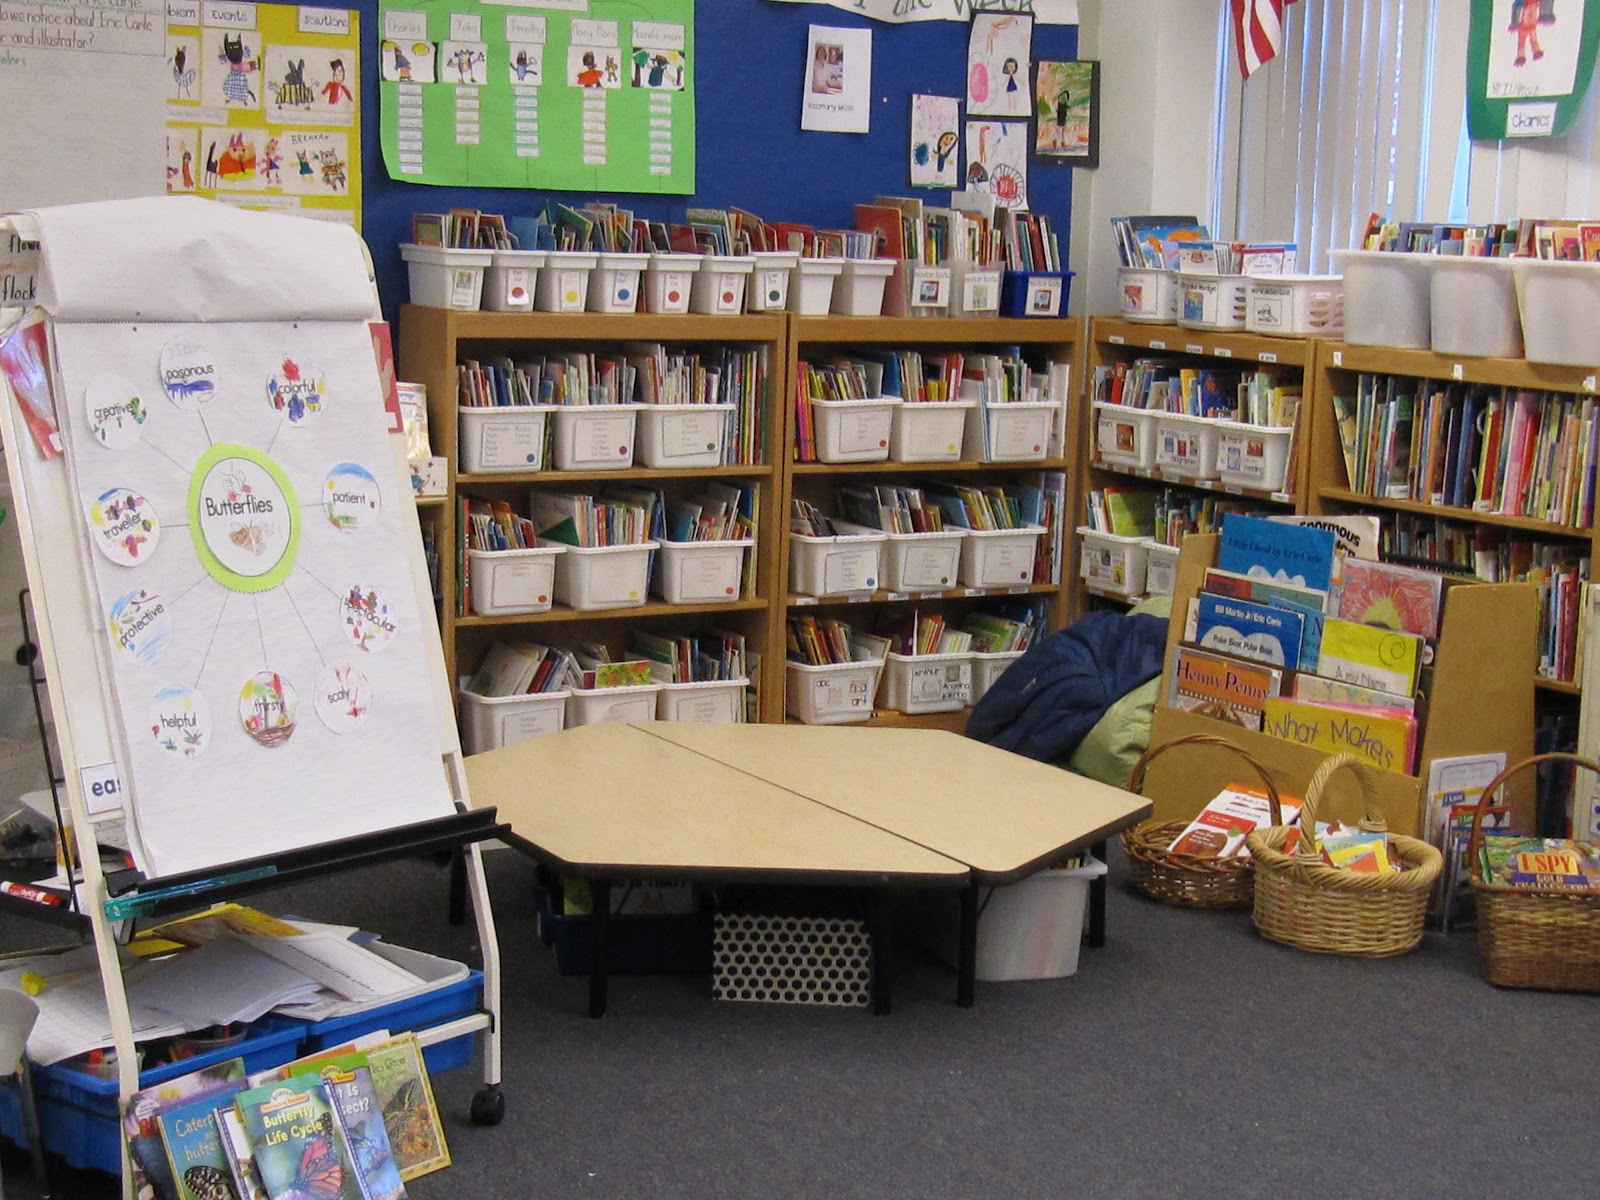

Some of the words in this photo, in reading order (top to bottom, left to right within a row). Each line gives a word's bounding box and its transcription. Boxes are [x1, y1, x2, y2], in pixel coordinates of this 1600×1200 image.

[65, 8, 95, 27] about
[125, 12, 152, 31] Carle
[12, 28, 34, 45] and
[3, 274, 36, 301] flock
[166, 364, 213, 380] poisonous
[278, 379, 315, 395] colorful
[94, 402, 133, 419] creative
[205, 495, 274, 517] Butterflies
[332, 492, 366, 506] patient
[103, 511, 143, 540] traveller
[344, 597, 396, 633] spectacular
[120, 603, 165, 649] protective
[1177, 659, 1221, 688] Henny
[1225, 671, 1268, 698] Penny
[1361, 672, 1387, 690] Name
[328, 685, 351, 704] scaly
[160, 712, 197, 731] helpful
[1266, 712, 1319, 744] What
[1331, 719, 1393, 769] Makes
[1522, 853, 1529, 871] I
[1535, 854, 1570, 873] SPY
[346, 1083, 359, 1097] Is
[263, 1105, 314, 1129] Butterfly
[265, 1129, 289, 1146] Life
[290, 1120, 323, 1139] Cycle
